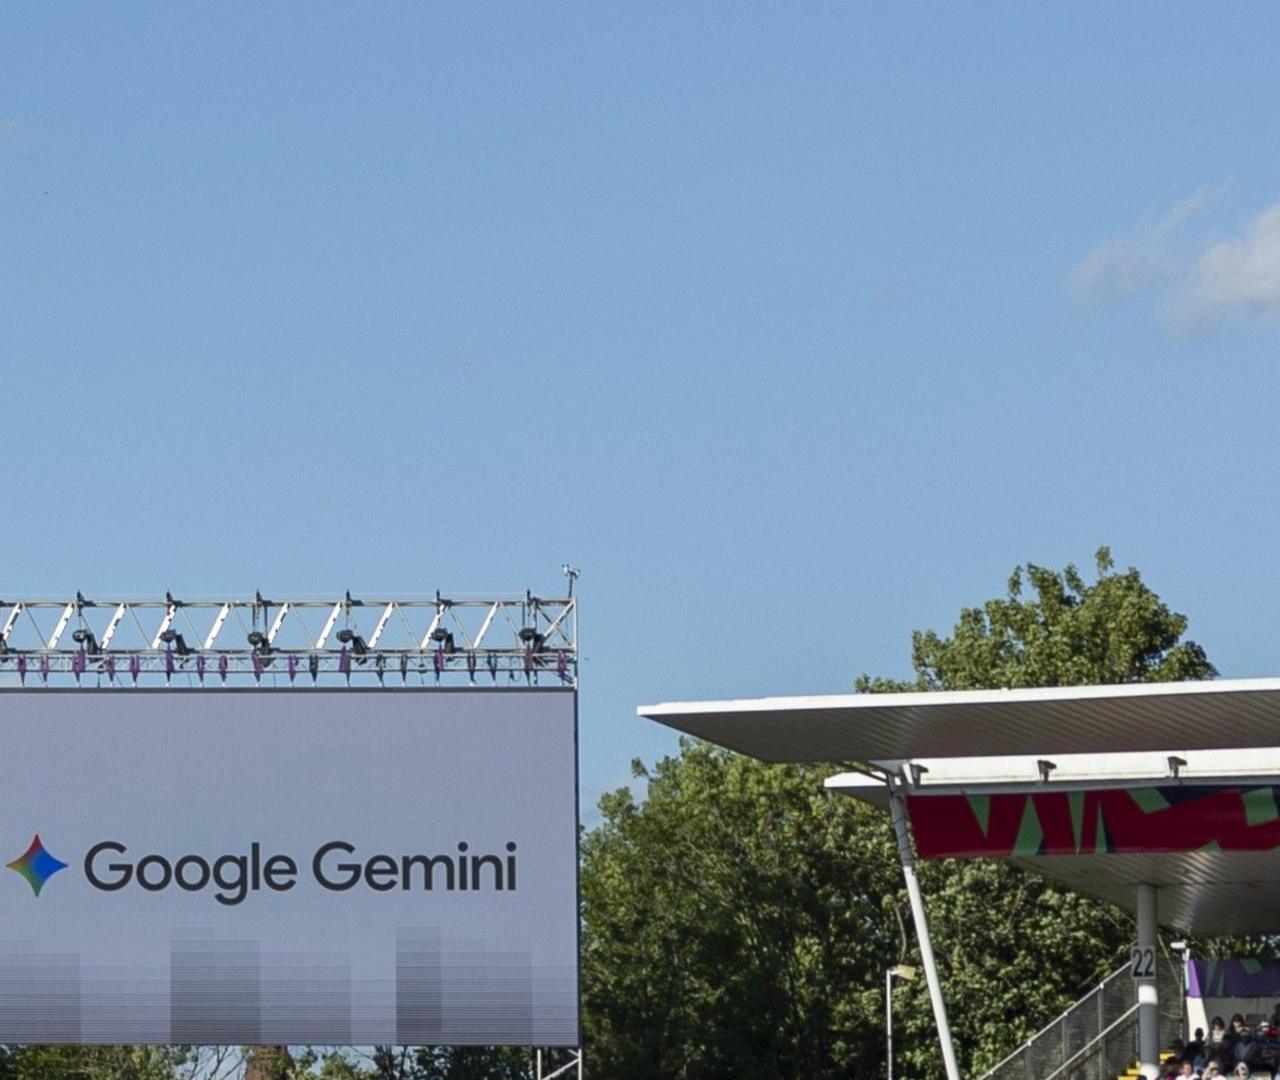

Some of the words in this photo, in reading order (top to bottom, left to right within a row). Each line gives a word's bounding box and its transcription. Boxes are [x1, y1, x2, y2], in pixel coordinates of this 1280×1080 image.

[83, 840, 298, 906] Google
[312, 840, 518, 892] Gemini
[1132, 949, 1155, 977] 22
